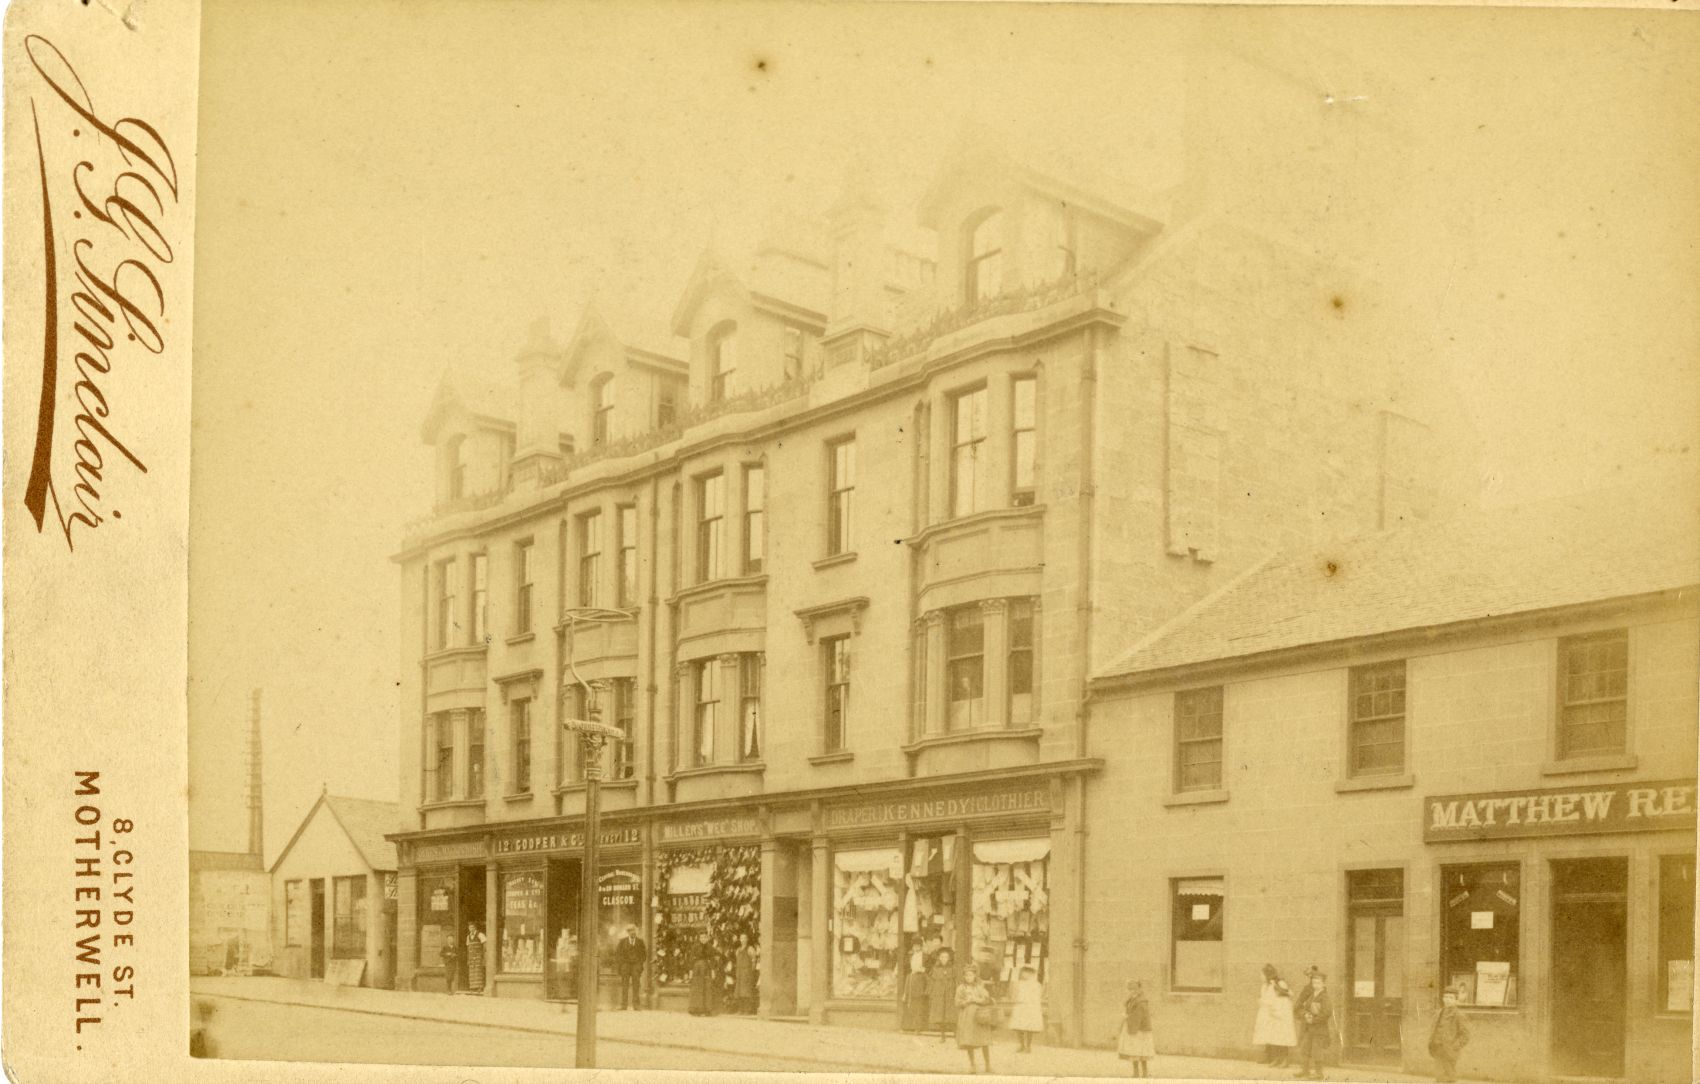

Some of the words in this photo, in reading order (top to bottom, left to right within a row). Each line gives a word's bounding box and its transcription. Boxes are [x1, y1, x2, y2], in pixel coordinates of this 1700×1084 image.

[68, 237, 165, 553] Sinclair
[831, 806, 878, 825] DRAPER
[882, 797, 970, 823] KENNEDY
[976, 790, 1045, 812] CLOTHIER
[1430, 790, 1616, 831] MATTHEW
[1626, 785, 1697, 818] RE
[498, 839, 509, 852] 12
[515, 835, 556, 851] COOPER
[560, 835, 568, 847] &
[625, 828, 638, 842] 12
[74, 770, 102, 1051] MOTHERWELL.
[112, 965, 134, 1007] ST.
